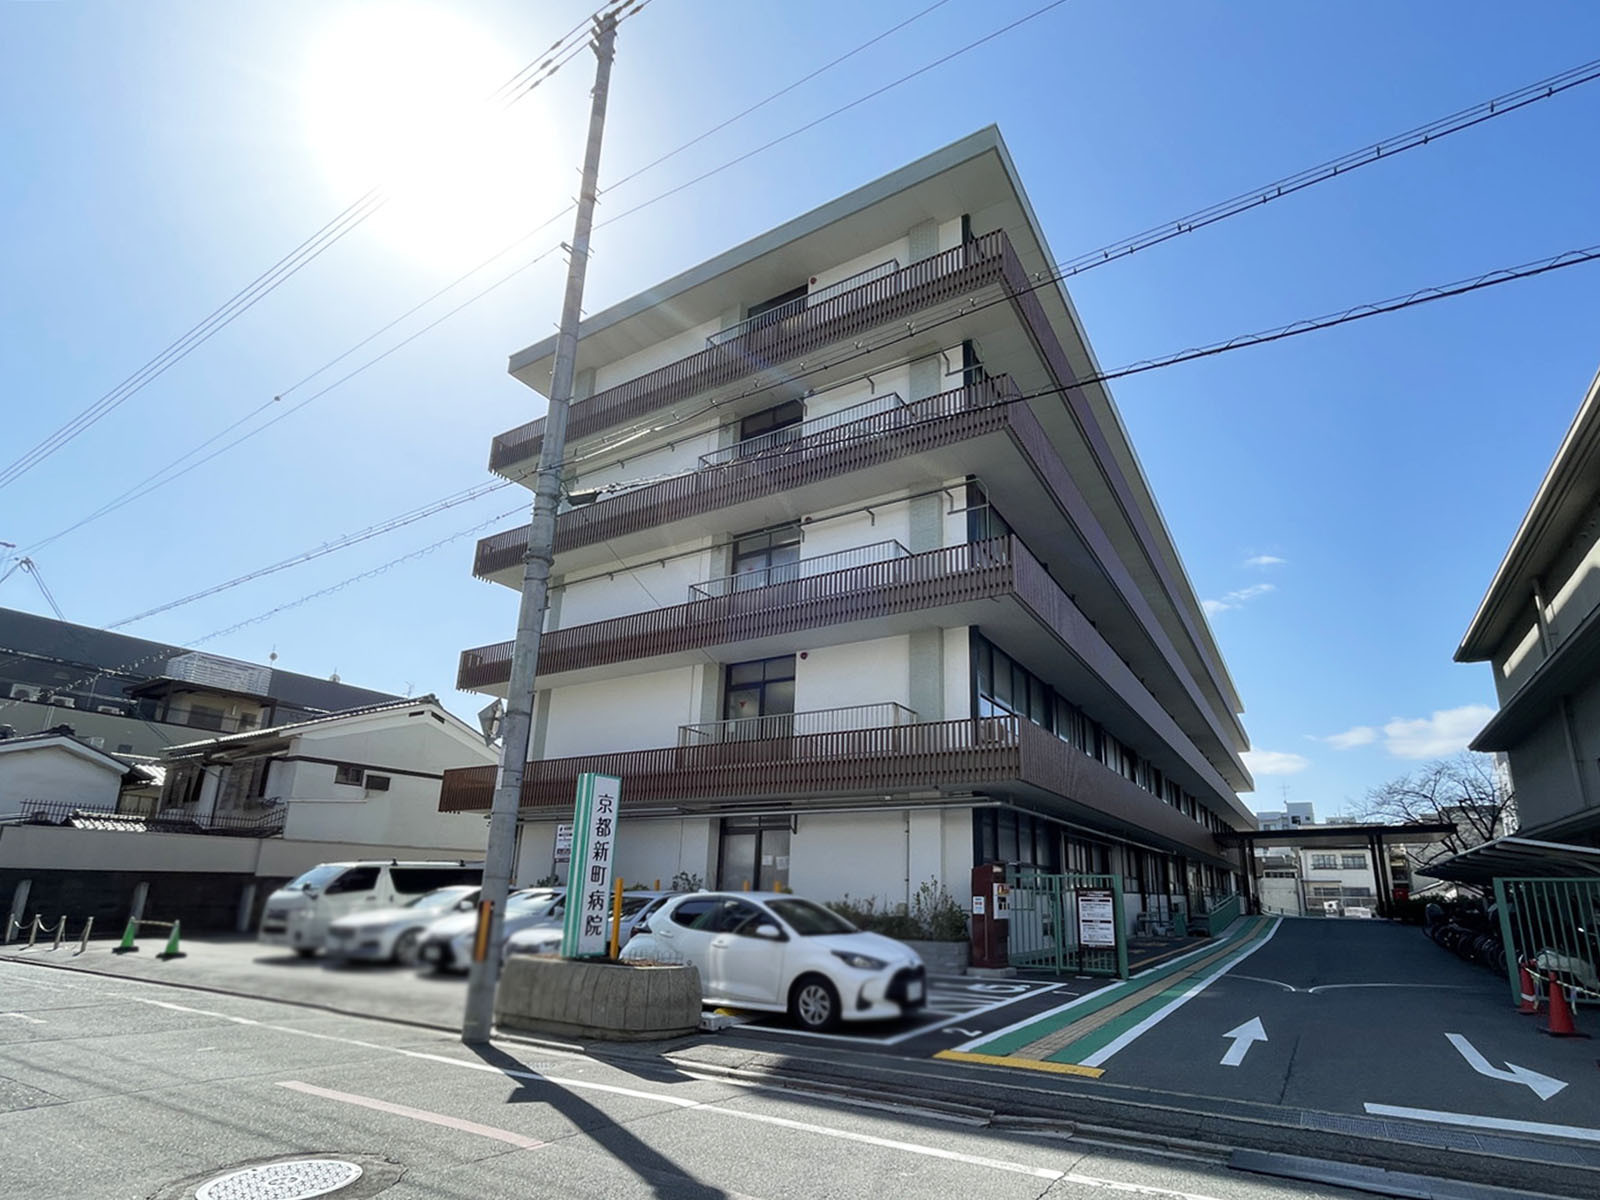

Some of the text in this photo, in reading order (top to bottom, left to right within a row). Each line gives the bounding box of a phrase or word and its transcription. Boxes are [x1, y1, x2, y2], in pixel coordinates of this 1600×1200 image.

[584, 793, 614, 936] 京都新町病院
